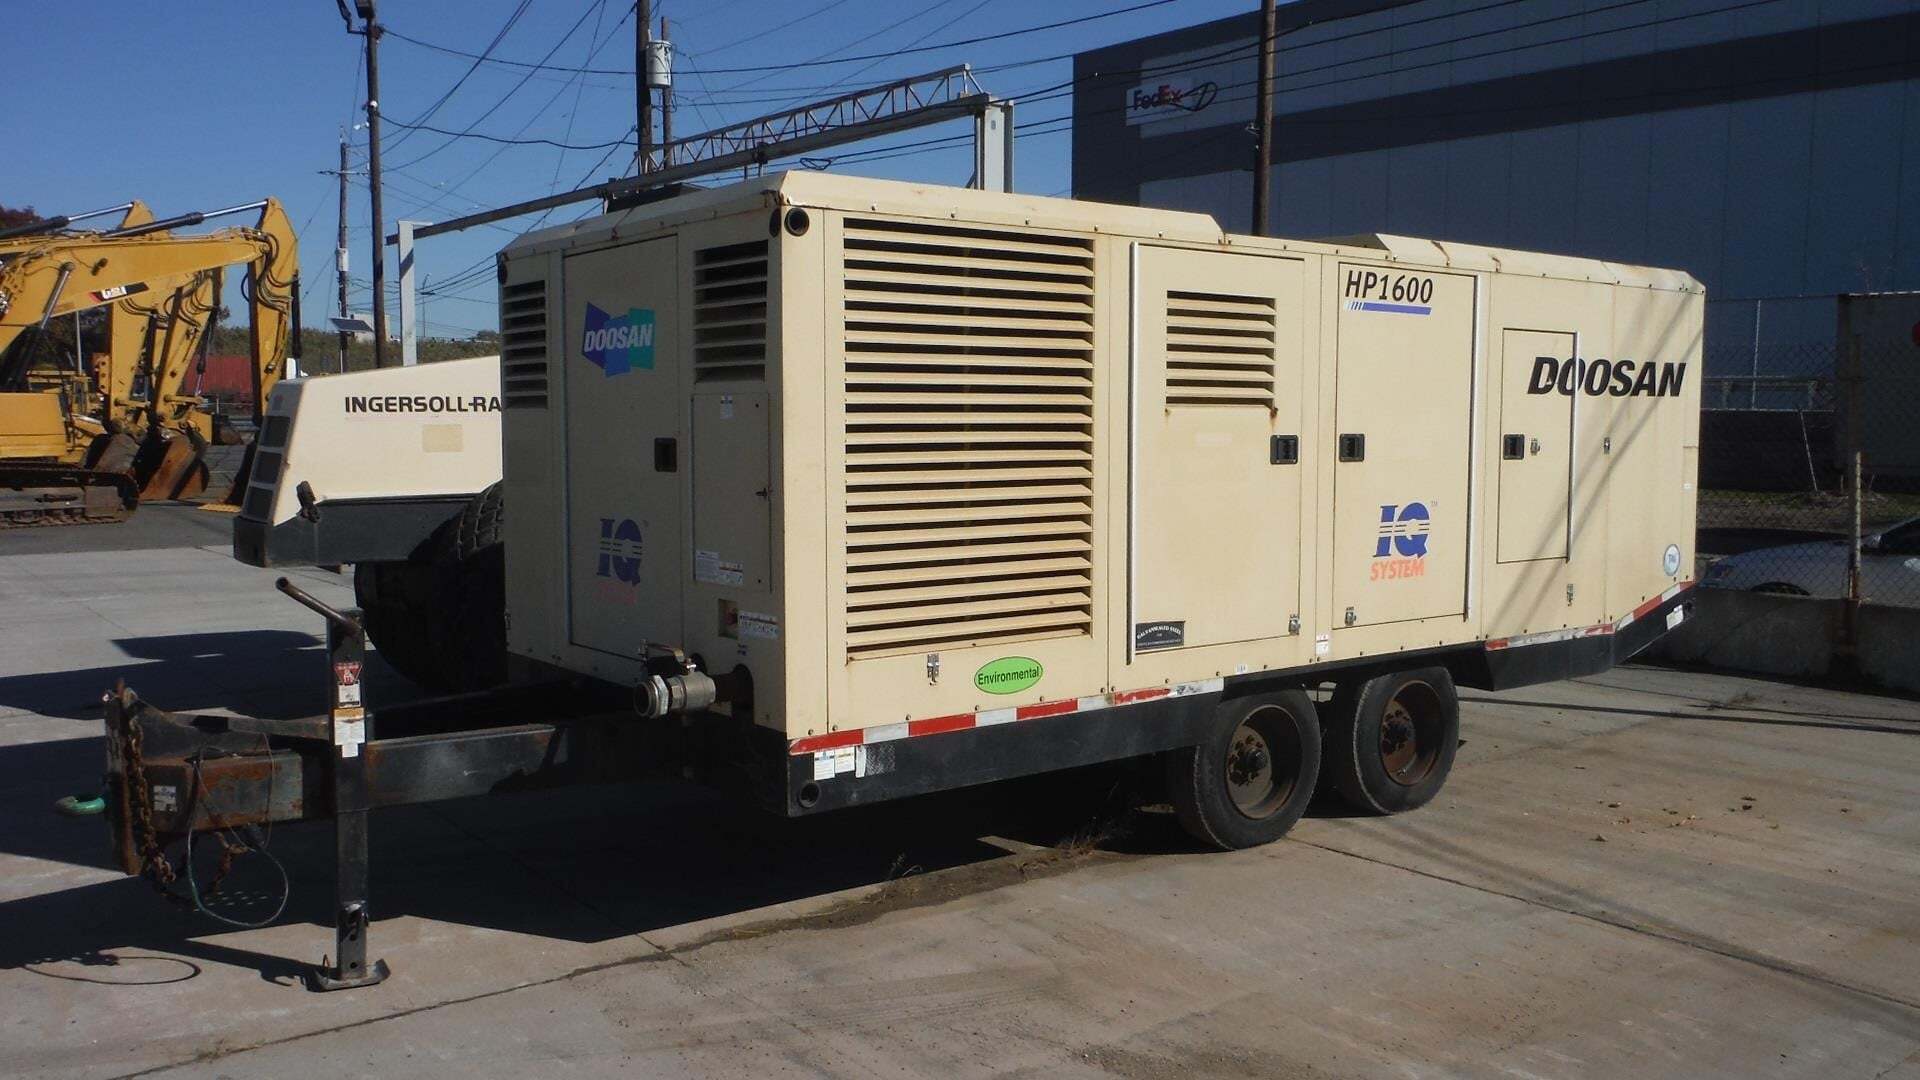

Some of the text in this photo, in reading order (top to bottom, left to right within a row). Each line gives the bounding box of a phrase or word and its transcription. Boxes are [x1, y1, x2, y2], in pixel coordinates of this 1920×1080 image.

[1134, 85, 1183, 110] FedEx
[1345, 270, 1433, 304] HP1600
[584, 324, 653, 352] DOOSAN
[1527, 356, 1687, 397] DOOSAN
[1372, 502, 1430, 559] IQ
[597, 519, 643, 587] IQ
[1370, 558, 1425, 581] SYSTEM
[978, 666, 1040, 686] Environmental
